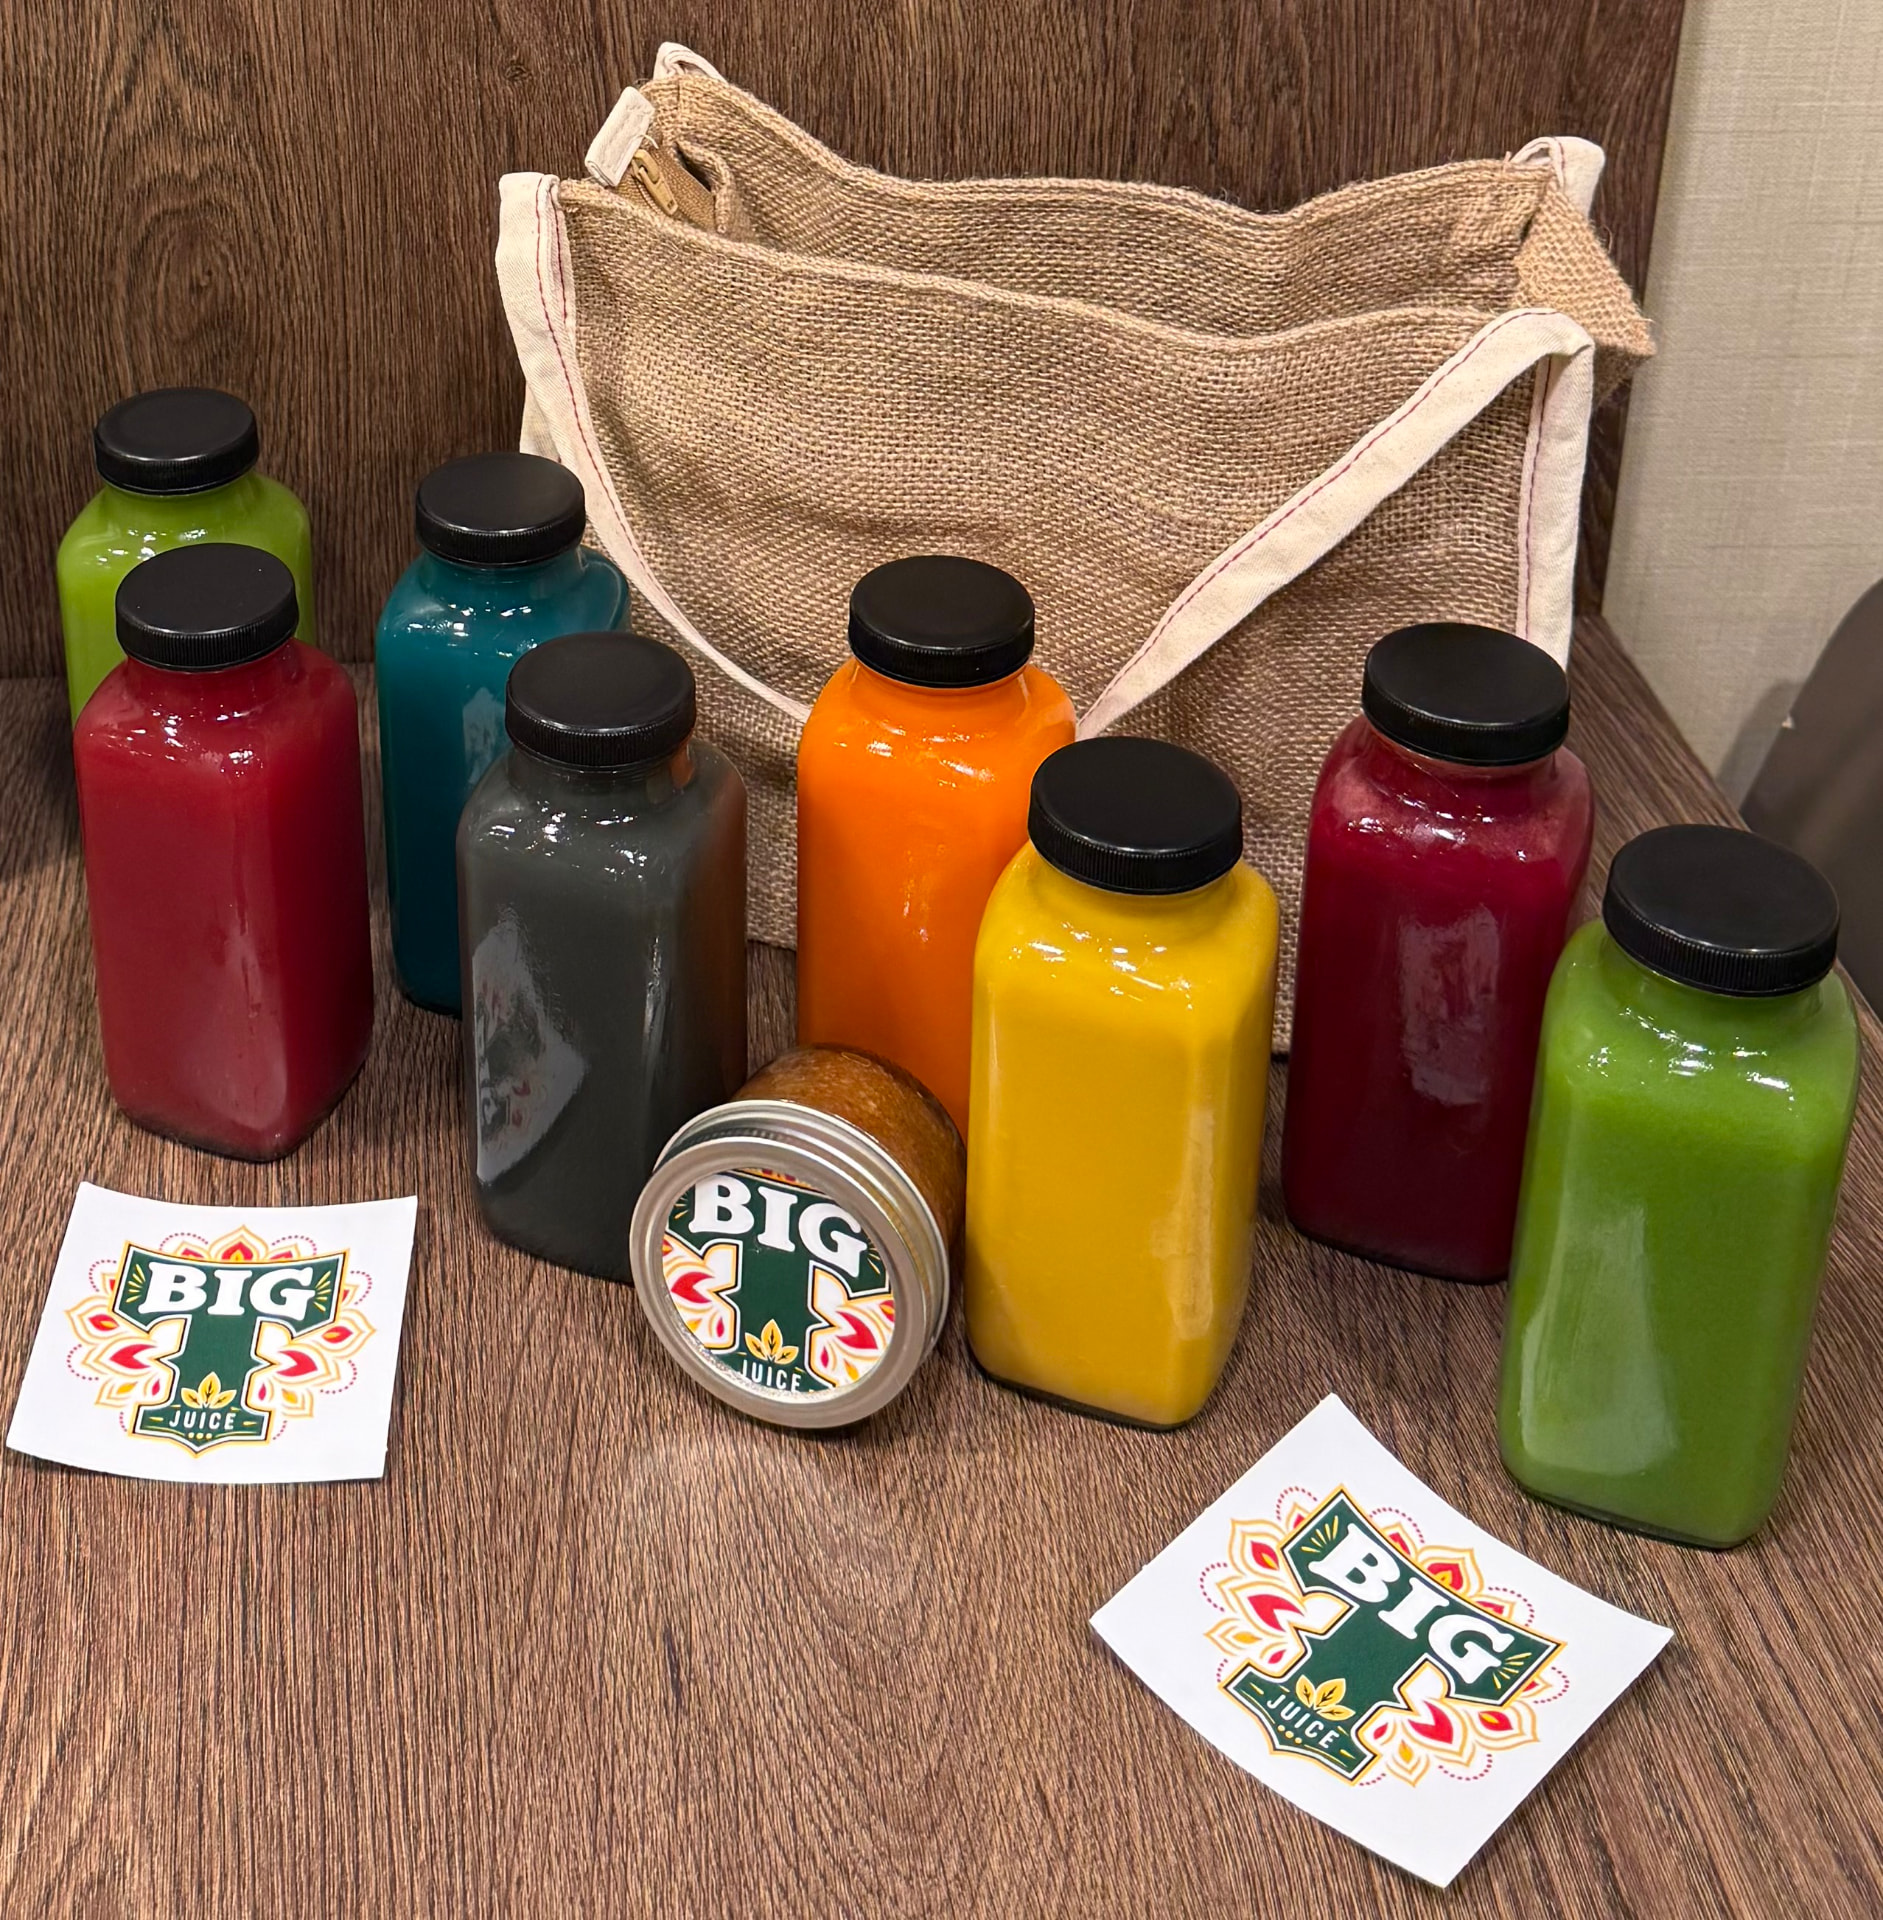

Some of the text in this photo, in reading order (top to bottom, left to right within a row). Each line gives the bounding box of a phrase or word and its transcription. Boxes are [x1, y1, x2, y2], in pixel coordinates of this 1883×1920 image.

[688, 1174, 868, 1277] BIG
[138, 1262, 316, 1320] BIG
[740, 1360, 801, 1391] JUICE
[168, 1410, 235, 1430] JUICE
[1308, 1523, 1515, 1684] BIG
[1267, 1693, 1340, 1749] JUICE
